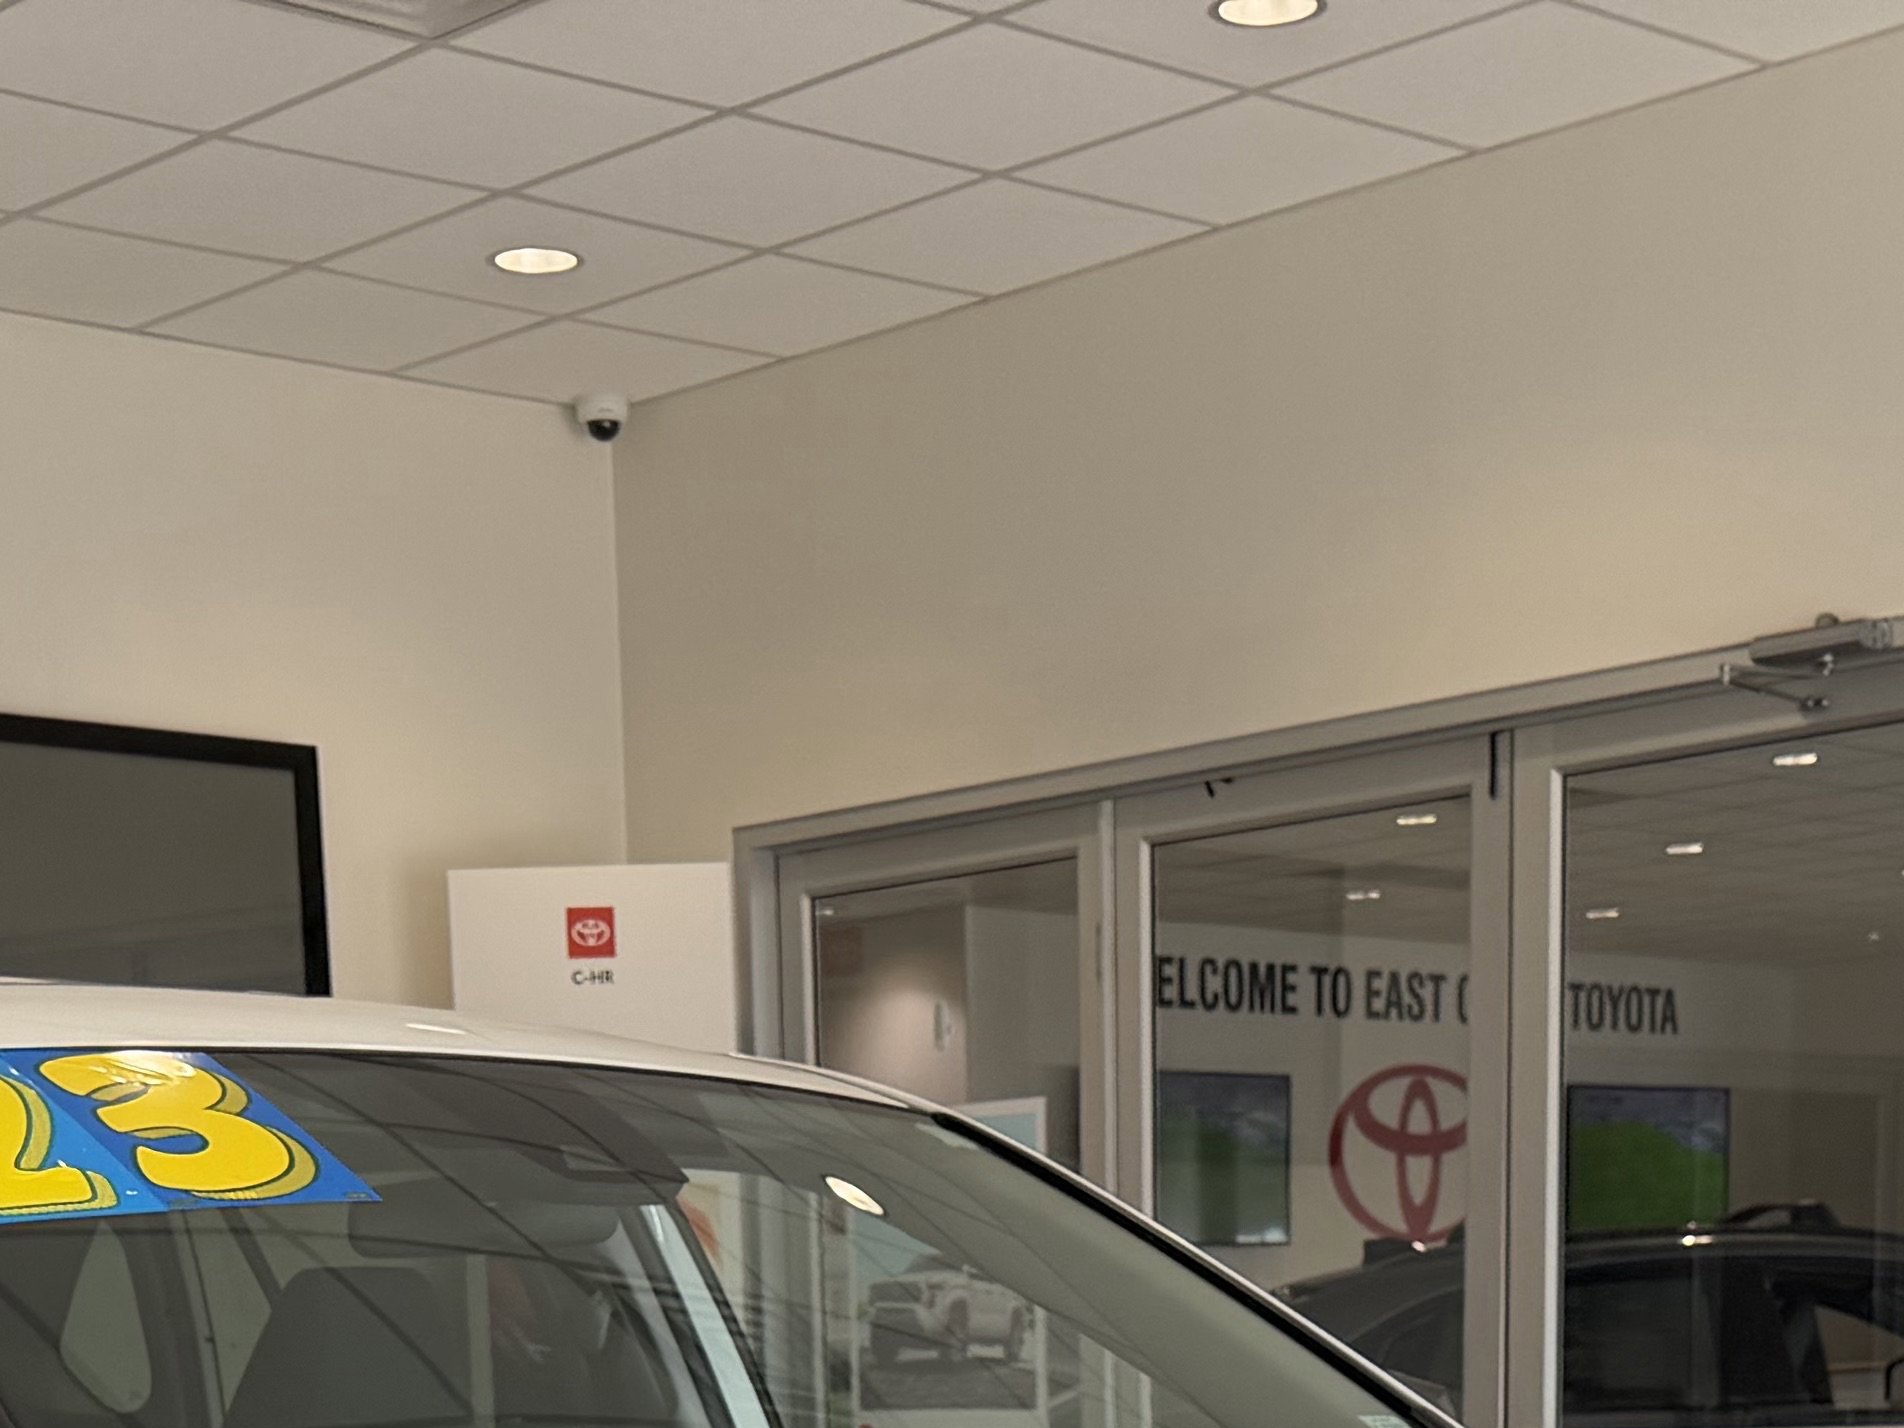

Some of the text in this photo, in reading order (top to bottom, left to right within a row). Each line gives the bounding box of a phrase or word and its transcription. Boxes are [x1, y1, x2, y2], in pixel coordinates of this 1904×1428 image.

[571, 969, 614, 985] C-HR
[1157, 955, 1299, 1015] ELCOME
[1308, 965, 1352, 1018] TO
[1364, 967, 1448, 1023] EAST
[1568, 981, 1678, 1035] TOYOTA
